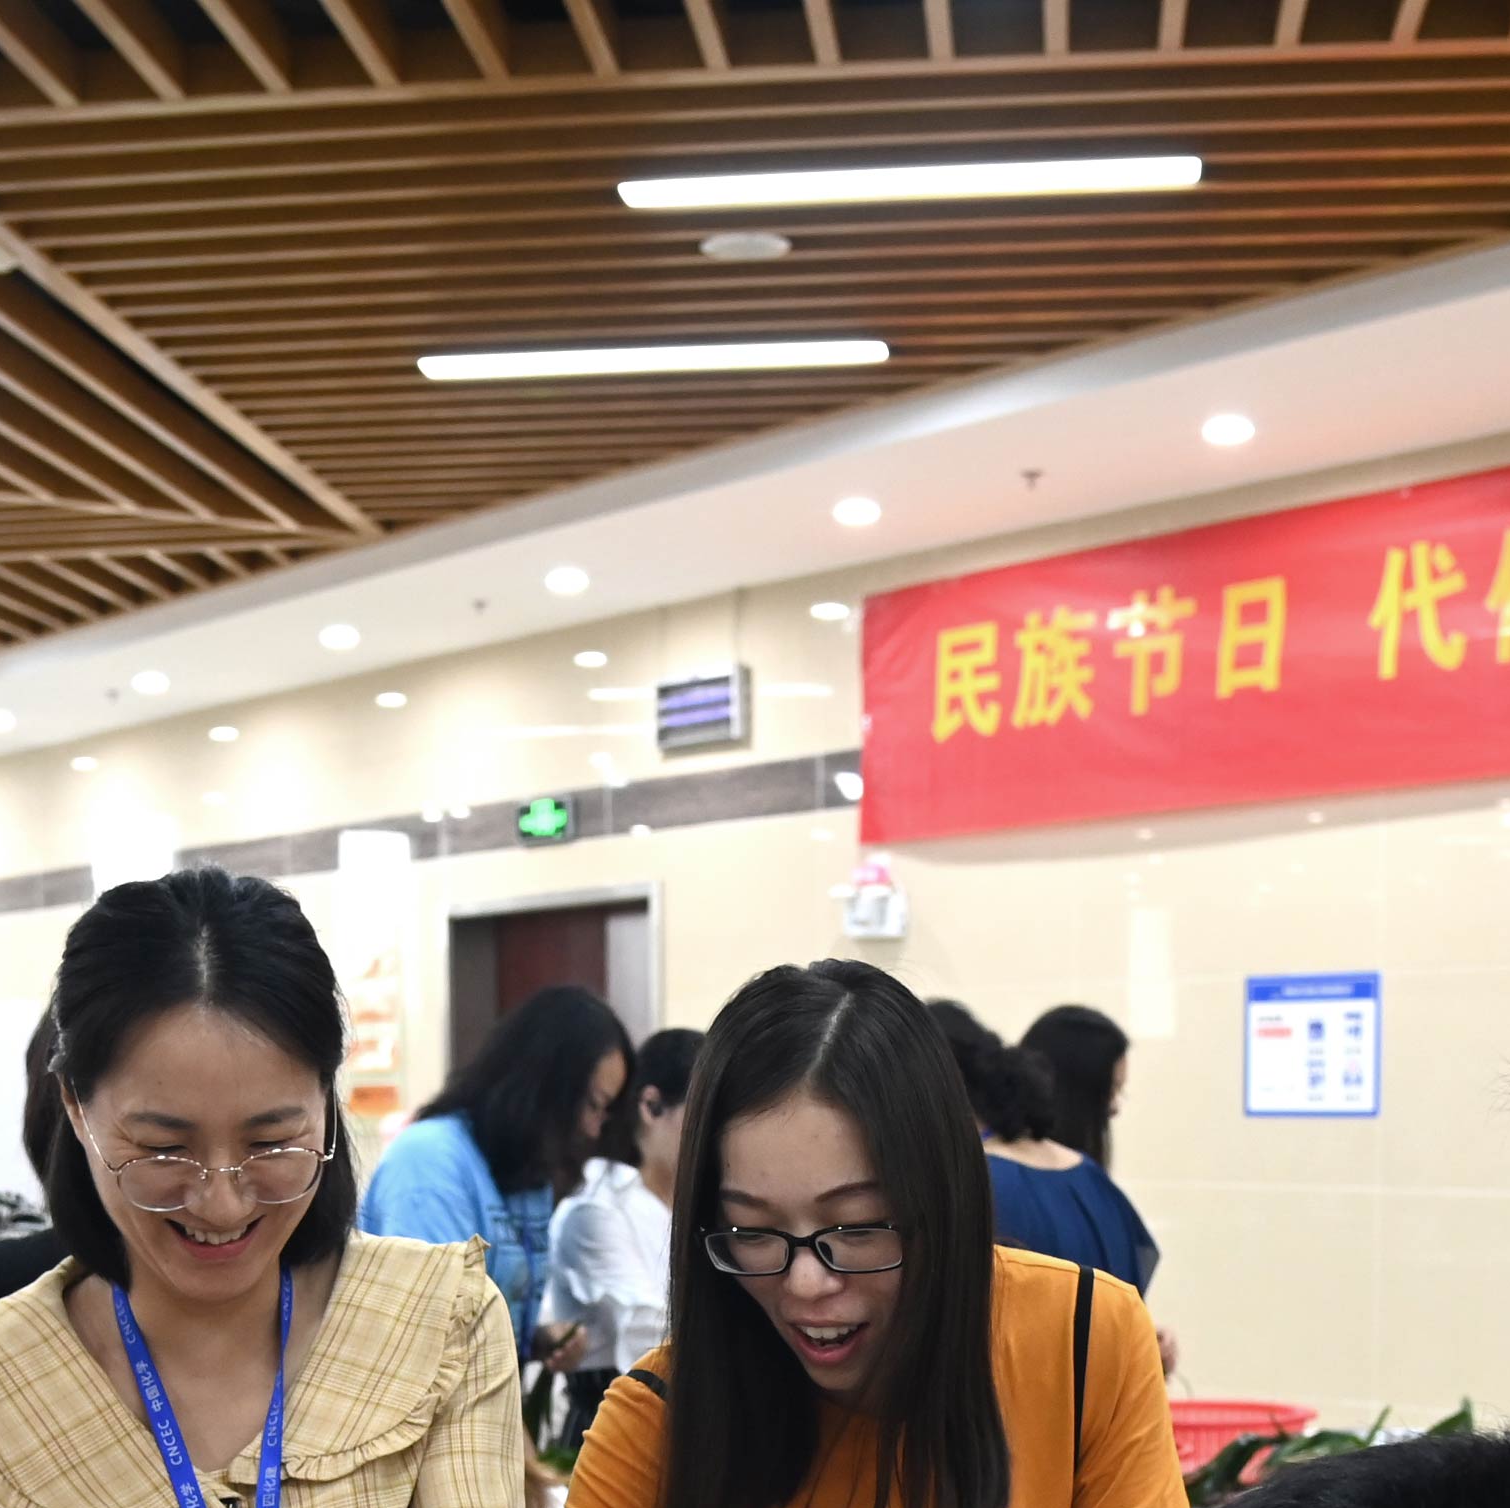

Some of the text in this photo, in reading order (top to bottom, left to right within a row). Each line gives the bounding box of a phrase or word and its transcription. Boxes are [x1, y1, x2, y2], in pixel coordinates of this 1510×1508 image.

[929, 575, 1289, 743] 民族节日
[157, 1419, 183, 1466] CNCEC
